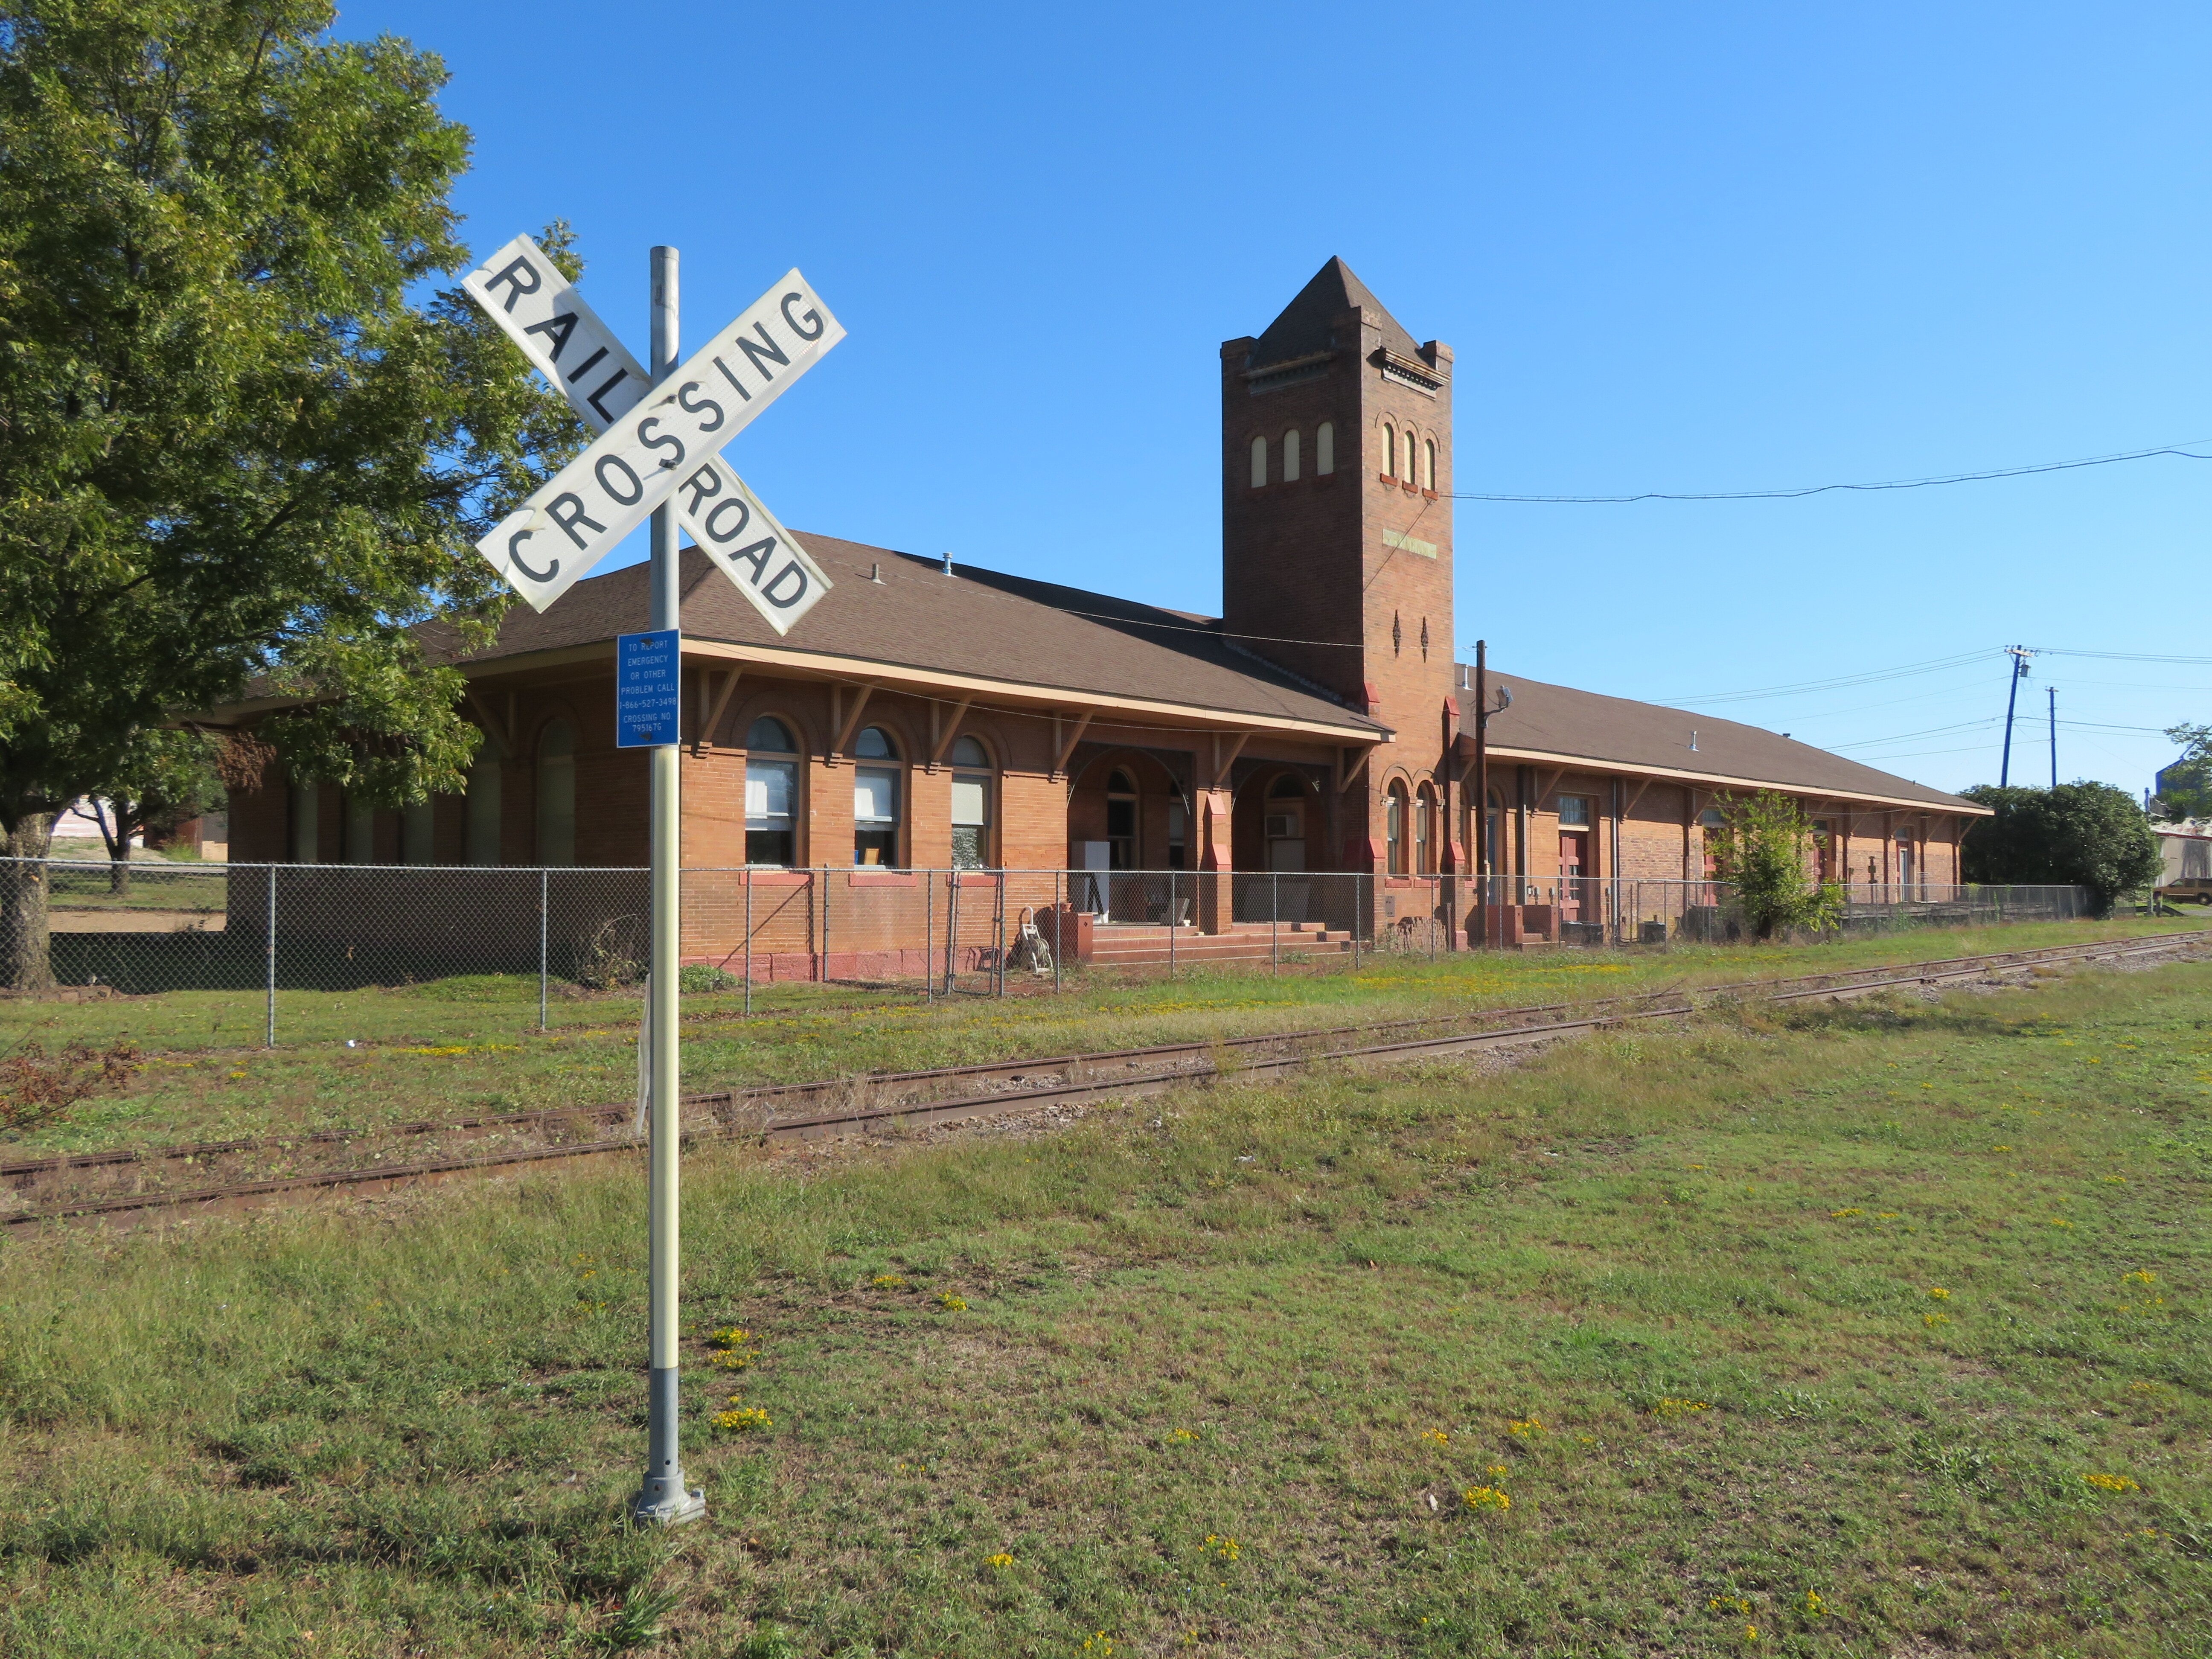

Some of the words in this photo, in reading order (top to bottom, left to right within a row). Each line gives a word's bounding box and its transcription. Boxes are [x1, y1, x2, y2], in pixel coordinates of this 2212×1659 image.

[484, 255, 630, 424] RAIL
[678, 463, 808, 608] ROAD
[508, 292, 824, 583] CROSSING
[629, 643, 637, 652] TO
[641, 640, 668, 651] REPORT
[628, 655, 669, 667] EMERGENCY
[630, 672, 640, 681] OR
[644, 669, 666, 679] OTHER
[621, 685, 653, 695] PROBLEM
[657, 683, 675, 692] CALL
[619, 697, 677, 709] 1-866-527-3498
[623, 713, 658, 723] CROSSING
[661, 712, 672, 720] NO.
[632, 723, 662, 732] 795167G
